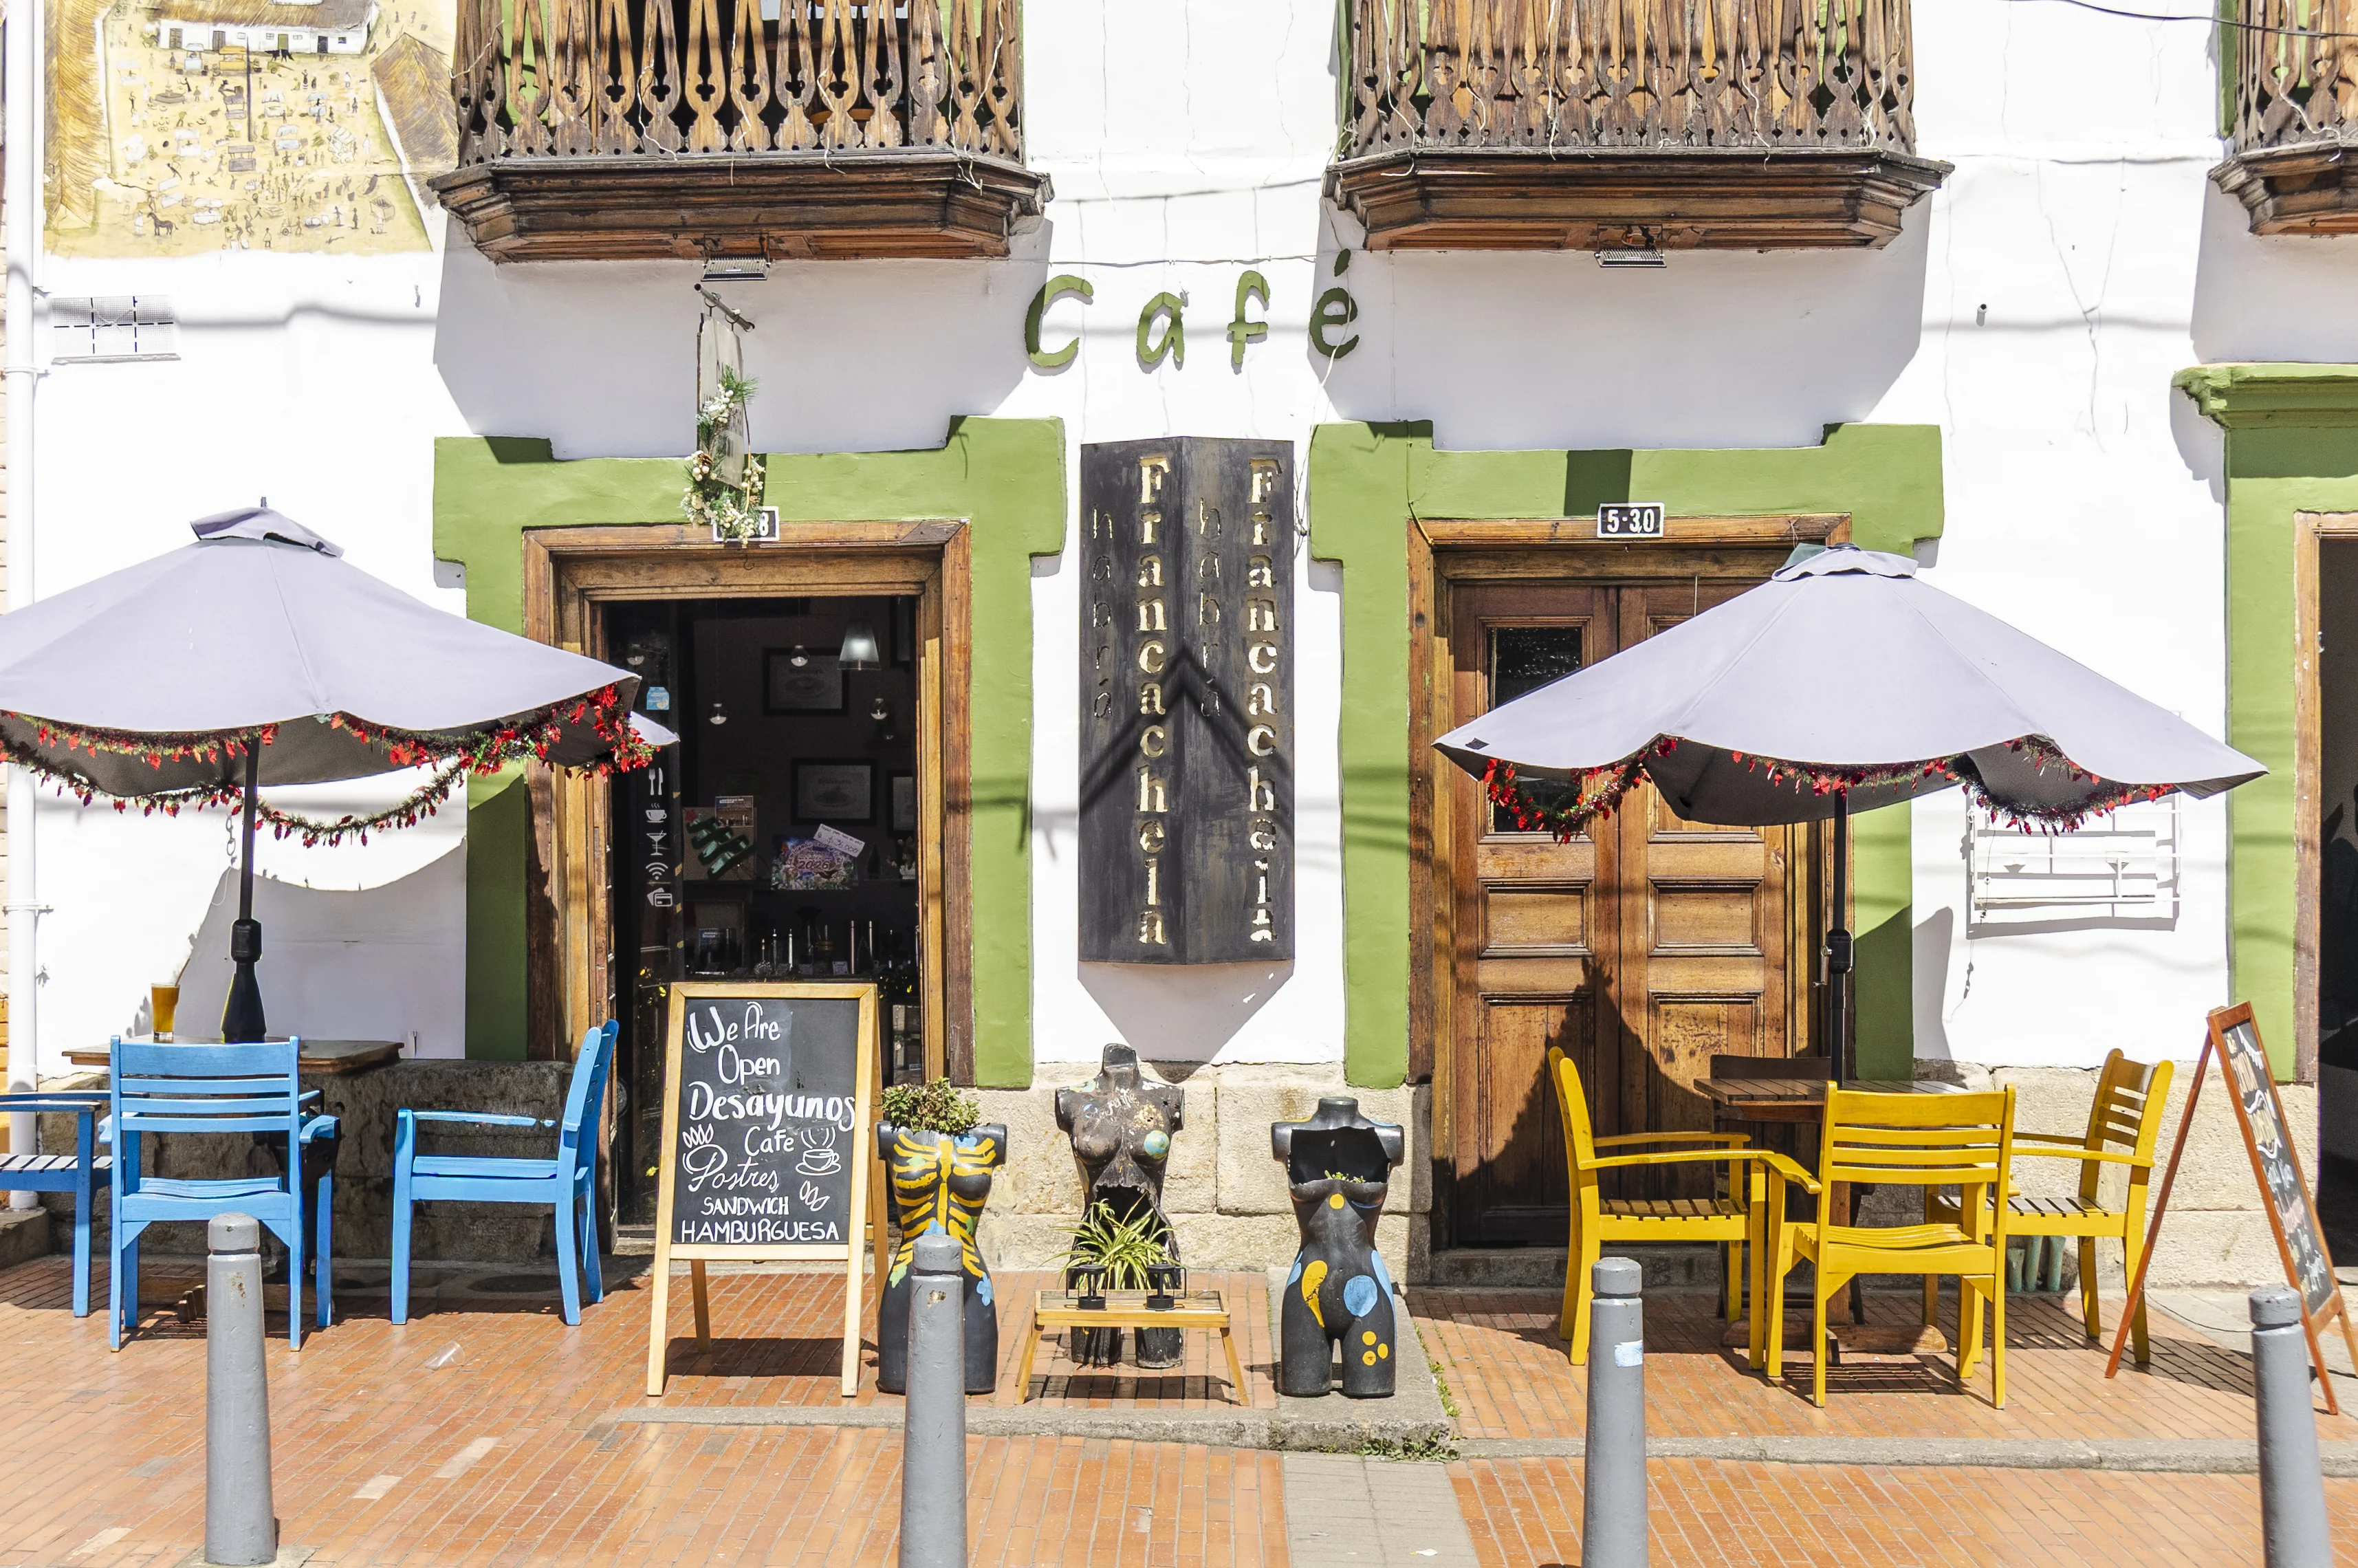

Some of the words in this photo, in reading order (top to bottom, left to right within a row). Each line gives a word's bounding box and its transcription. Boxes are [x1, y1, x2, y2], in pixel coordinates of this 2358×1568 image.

[1025, 248, 1360, 367] Café
[1606, 509, 1655, 533] 5-30
[1136, 457, 1170, 945] Francachela
[1246, 458, 1282, 942] Francachela
[798, 860, 829, 869] 2026
[688, 1006, 738, 1053] We
[744, 1001, 780, 1041] Are
[718, 1044, 780, 1085] Open
[689, 1081, 855, 1132] Desayunos
[700, 1196, 789, 1215] SANDWICH
[681, 1219, 840, 1243] HAMBURGUESA
